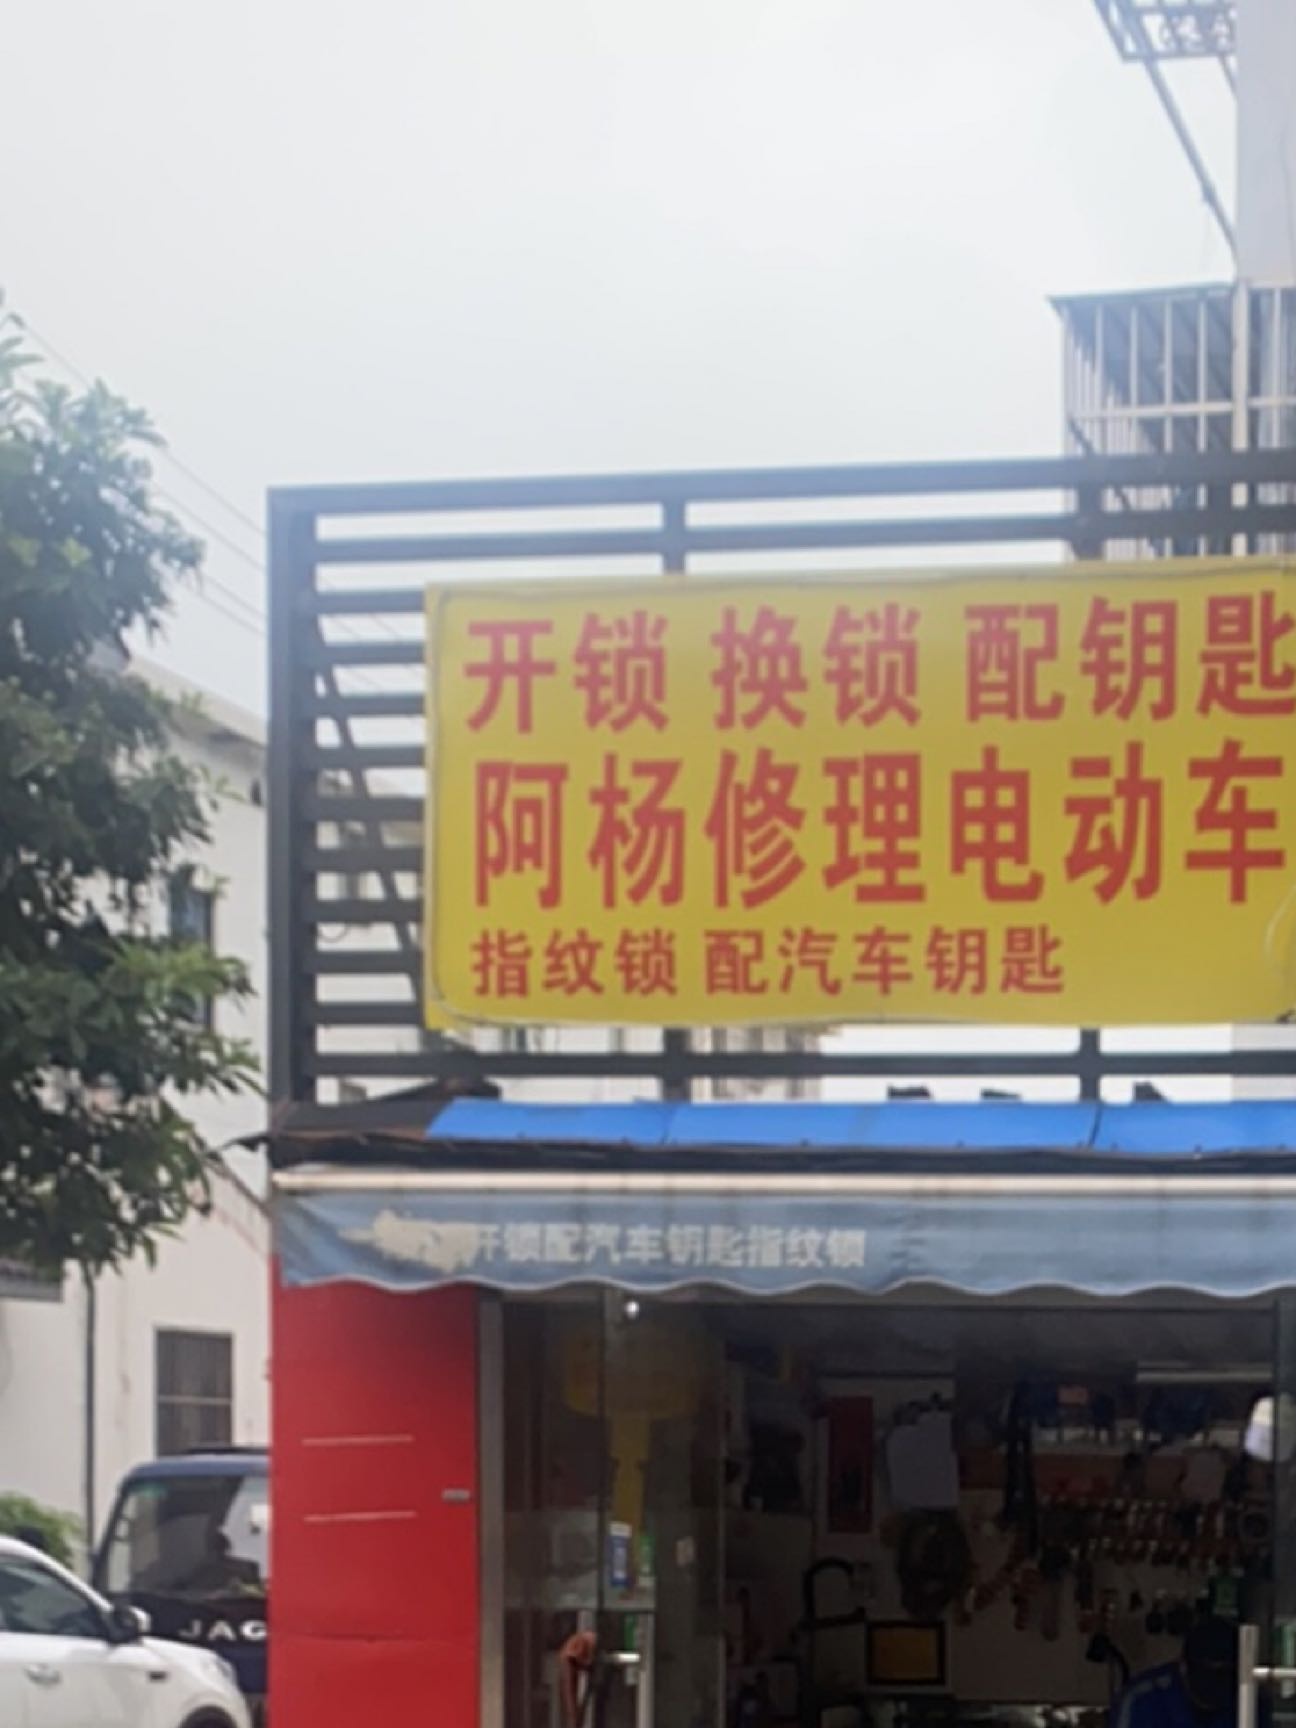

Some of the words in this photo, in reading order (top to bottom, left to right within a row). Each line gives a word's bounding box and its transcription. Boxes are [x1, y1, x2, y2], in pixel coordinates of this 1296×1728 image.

[463, 608, 670, 734] 开锁
[709, 602, 922, 731] 换锁
[473, 737, 1288, 911] 阿杨修理电动车
[470, 927, 678, 998] 指纹锁
[703, 923, 1066, 997] 配汽车钥匙
